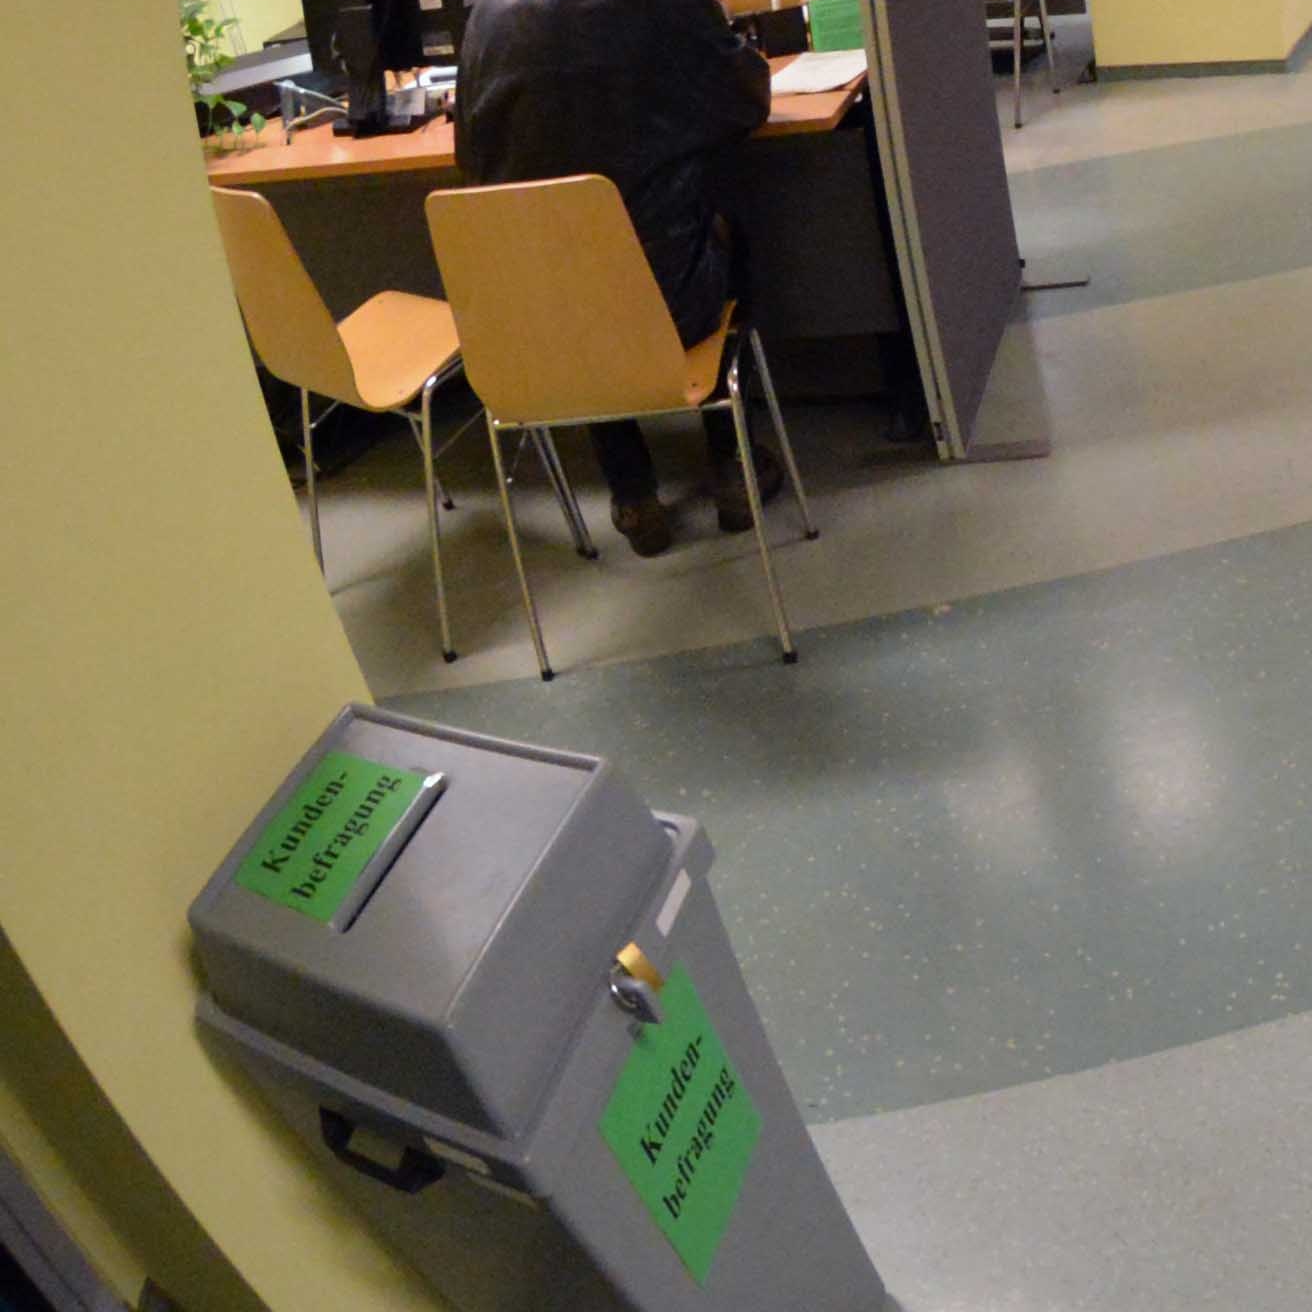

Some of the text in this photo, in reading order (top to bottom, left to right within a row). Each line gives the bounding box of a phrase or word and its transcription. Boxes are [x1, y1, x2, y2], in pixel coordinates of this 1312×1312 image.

[260, 771, 348, 874] Kunden-
[289, 775, 402, 898] befragung
[640, 1035, 703, 1167] Kunden-
[662, 1067, 735, 1219] befragung
